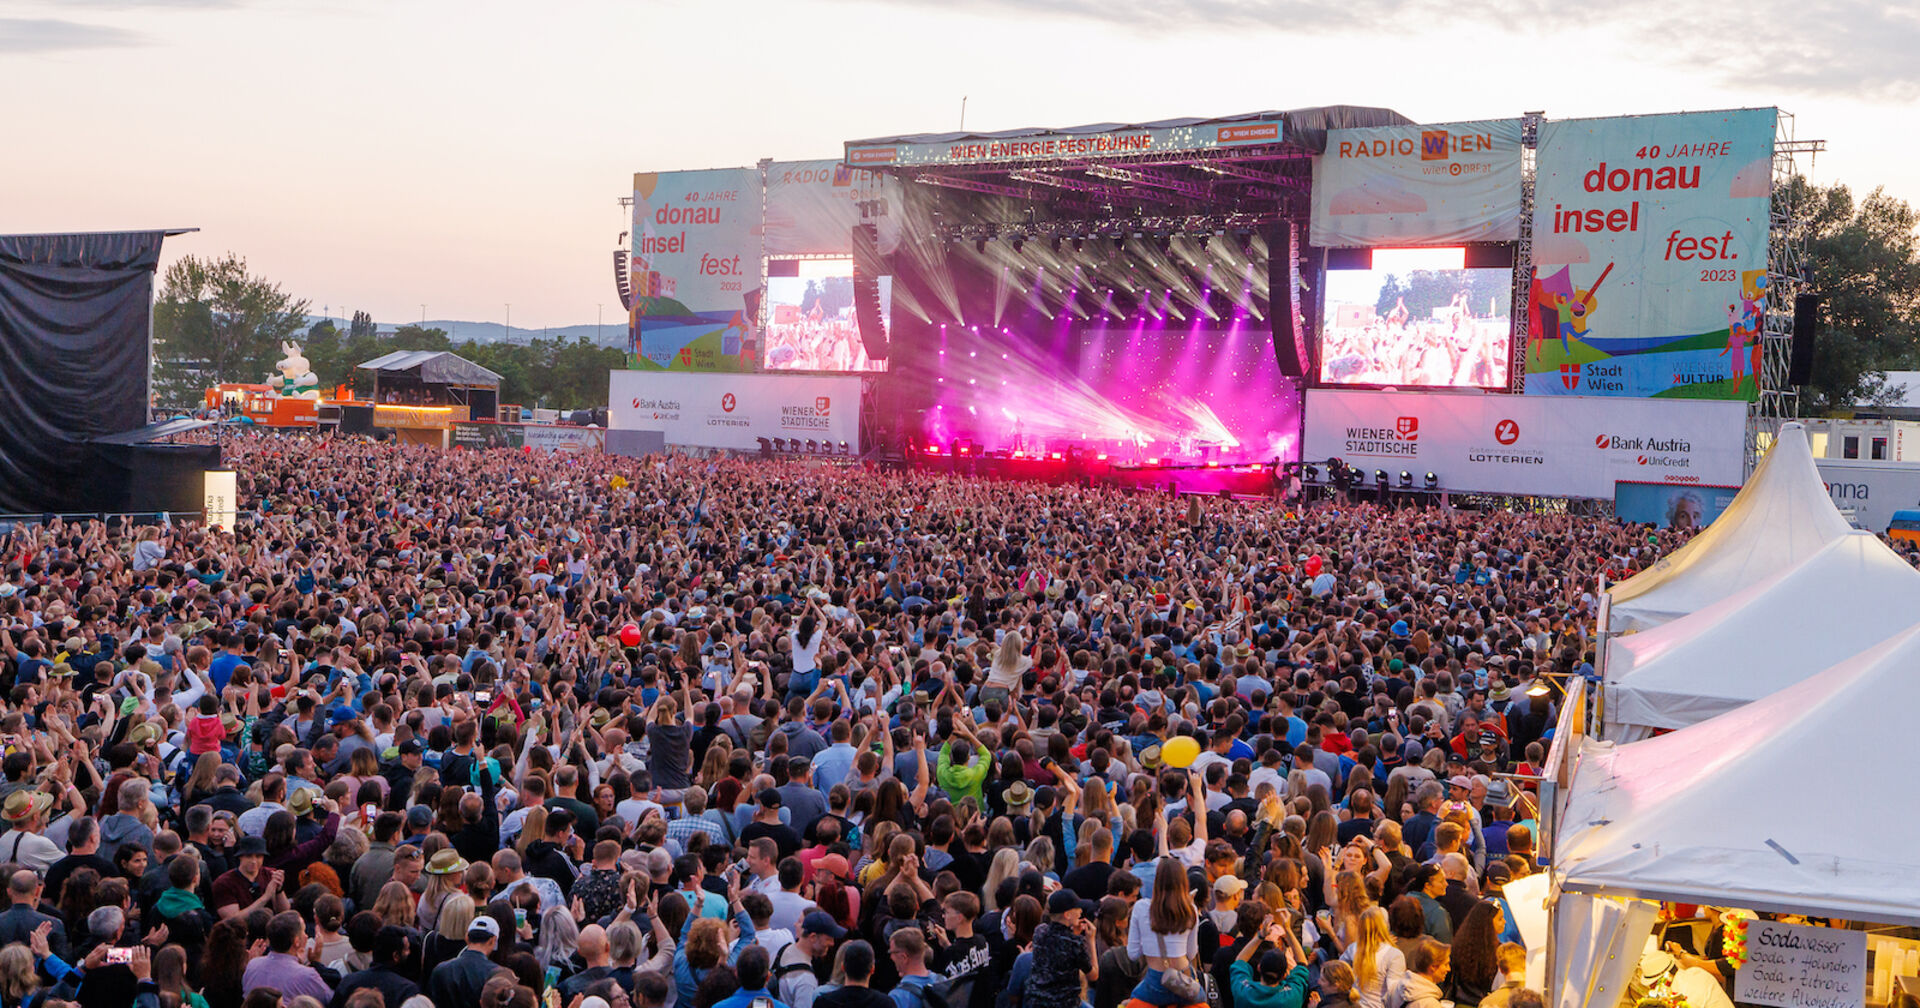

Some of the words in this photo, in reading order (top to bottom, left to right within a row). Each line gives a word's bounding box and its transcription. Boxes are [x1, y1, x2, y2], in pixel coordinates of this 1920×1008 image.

[951, 144, 987, 159] WIEN
[991, 140, 1055, 157] ENERGIE
[1058, 133, 1151, 154] FESTBÜHNE
[1339, 138, 1415, 159] RADIO
[1423, 133, 1492, 155] WIEN
[1635, 145, 1661, 160] 40
[1666, 141, 1733, 159] JAHRE
[784, 169, 830, 184] RADIO
[1422, 166, 1447, 176] wien
[1583, 162, 1701, 193] donau
[684, 191, 700, 202] 40
[701, 189, 739, 202] JAHRE
[656, 202, 721, 225] donau
[1554, 201, 1639, 234] insel
[642, 231, 686, 254] insel
[1664, 230, 1738, 261] fest.
[700, 252, 743, 276] fest.
[1700, 269, 1737, 282] 2023
[719, 281, 743, 292] 2023
[1586, 363, 1623, 377] Stadt
[1587, 378, 1624, 391] Wien
[1673, 373, 1725, 384] KULTUR
[640, 399, 657, 409] Bank
[658, 400, 680, 410] Austria
[781, 405, 815, 416] WIENER
[706, 419, 750, 427] LOTTERIEN
[1346, 427, 1395, 440] WIENER
[1345, 440, 1418, 454] STÄDTISCHE
[1611, 435, 1643, 450] Bank
[1646, 437, 1691, 452] Austria
[1469, 454, 1544, 464] LOTTERIEN
[1648, 456, 1690, 467] UniCredit
[1758, 927, 1846, 953] Sodawasser
[1751, 947, 1786, 965] Soda
[1753, 965, 1785, 983] Soda
